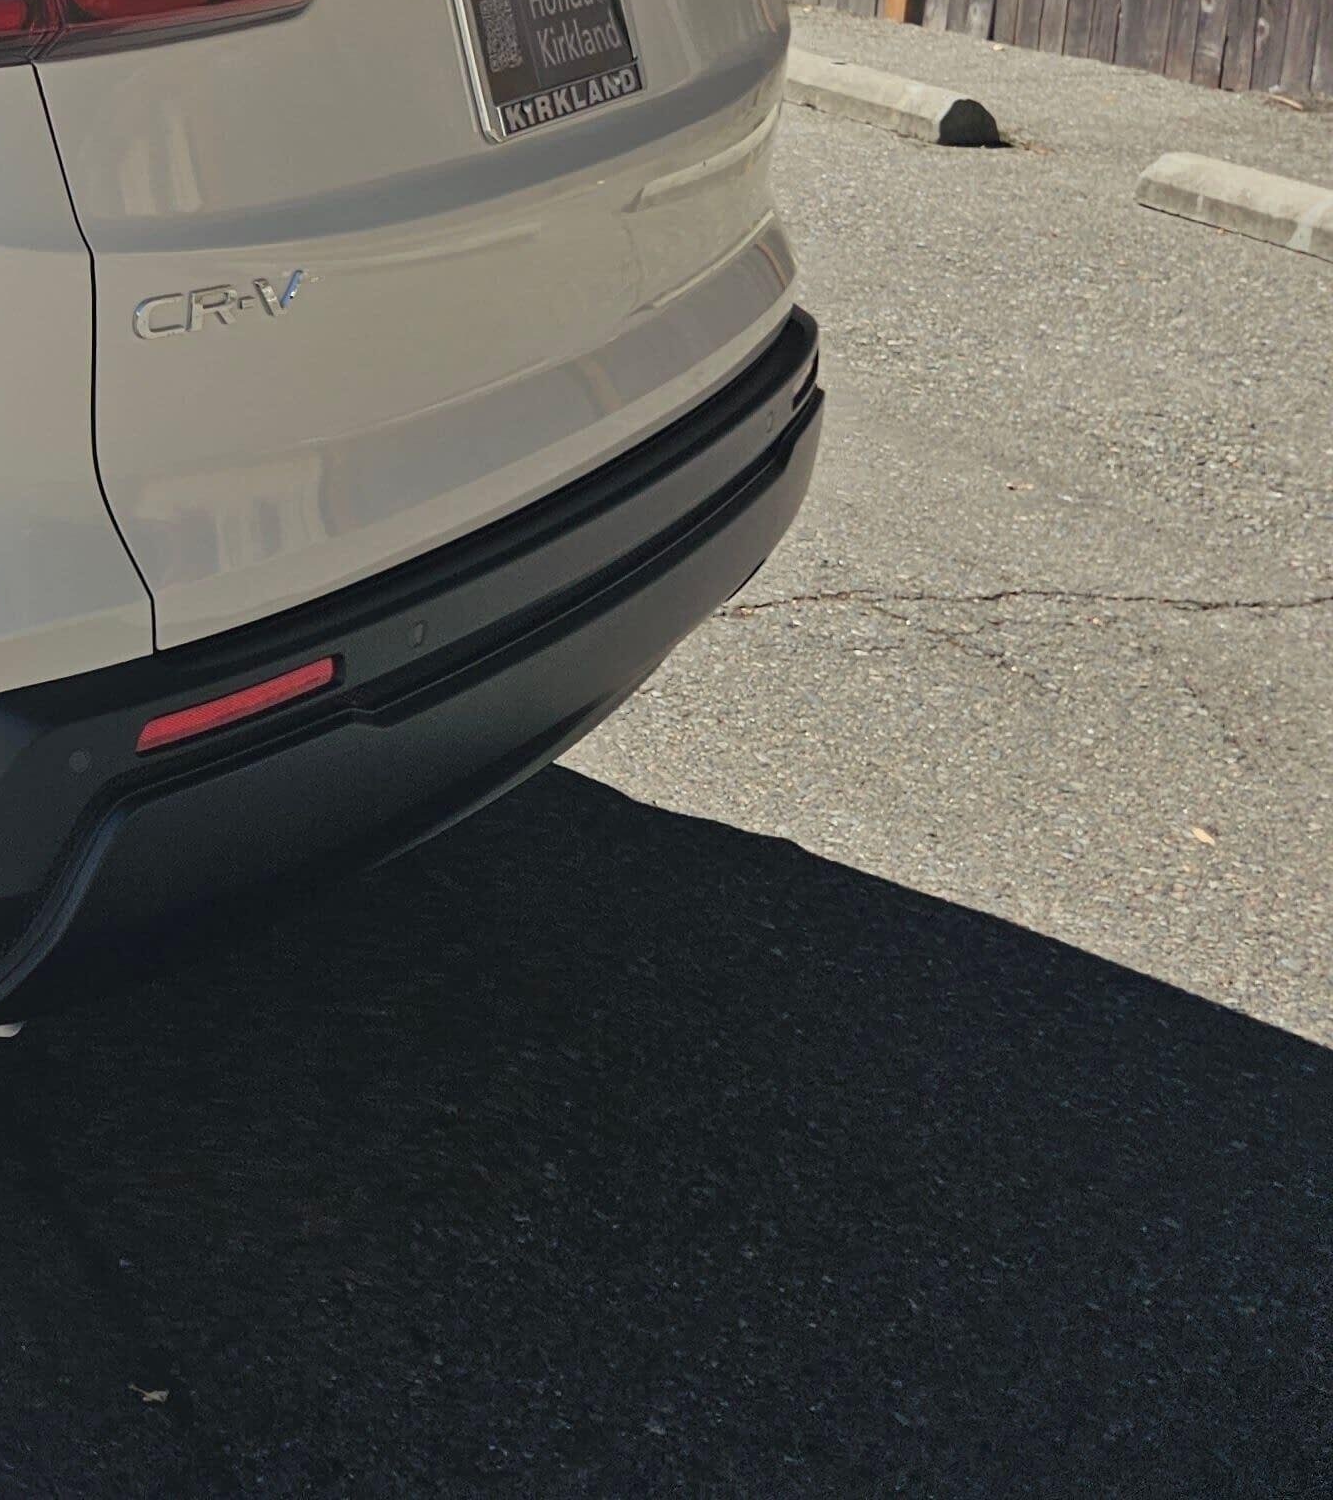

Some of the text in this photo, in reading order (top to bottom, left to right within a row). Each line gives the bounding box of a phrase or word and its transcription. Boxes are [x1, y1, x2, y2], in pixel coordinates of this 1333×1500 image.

[536, 11, 622, 69] Kirkland
[507, 69, 638, 131] KIRKLAND
[132, 269, 304, 340] CR-V
